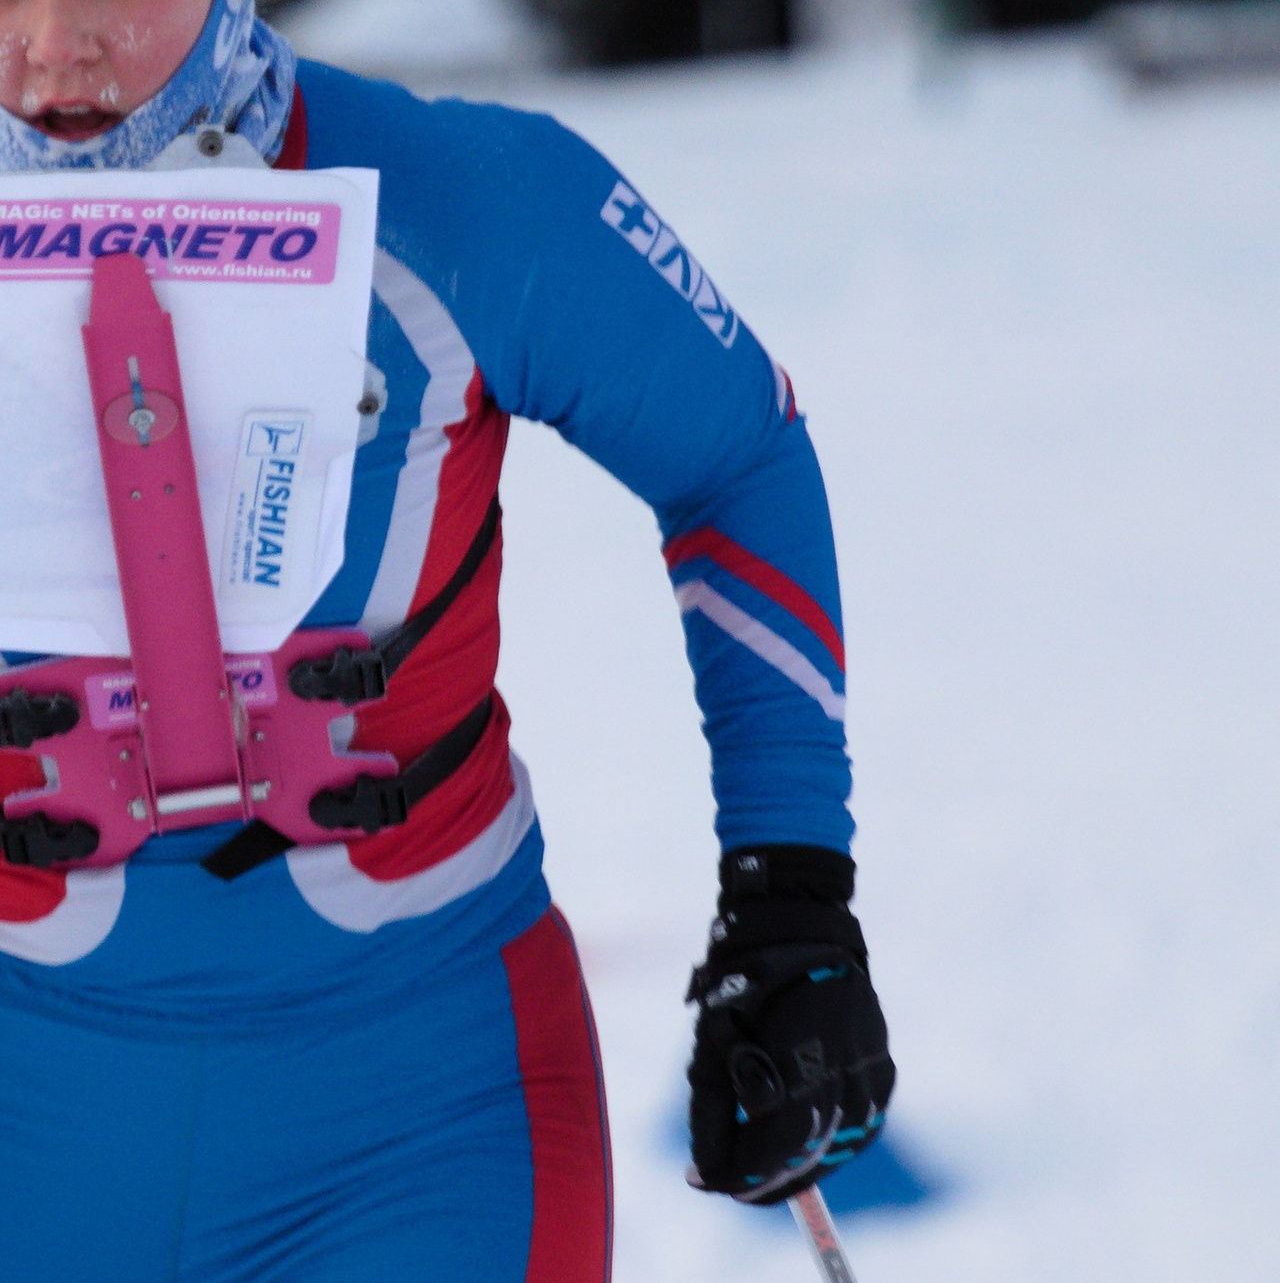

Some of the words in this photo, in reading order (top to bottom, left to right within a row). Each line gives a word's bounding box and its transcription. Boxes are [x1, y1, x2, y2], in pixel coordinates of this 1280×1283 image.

[71, 204, 135, 219] NETs
[141, 204, 167, 220] of
[172, 204, 322, 226] Orienteering
[253, 458, 296, 588] FISHIAN
